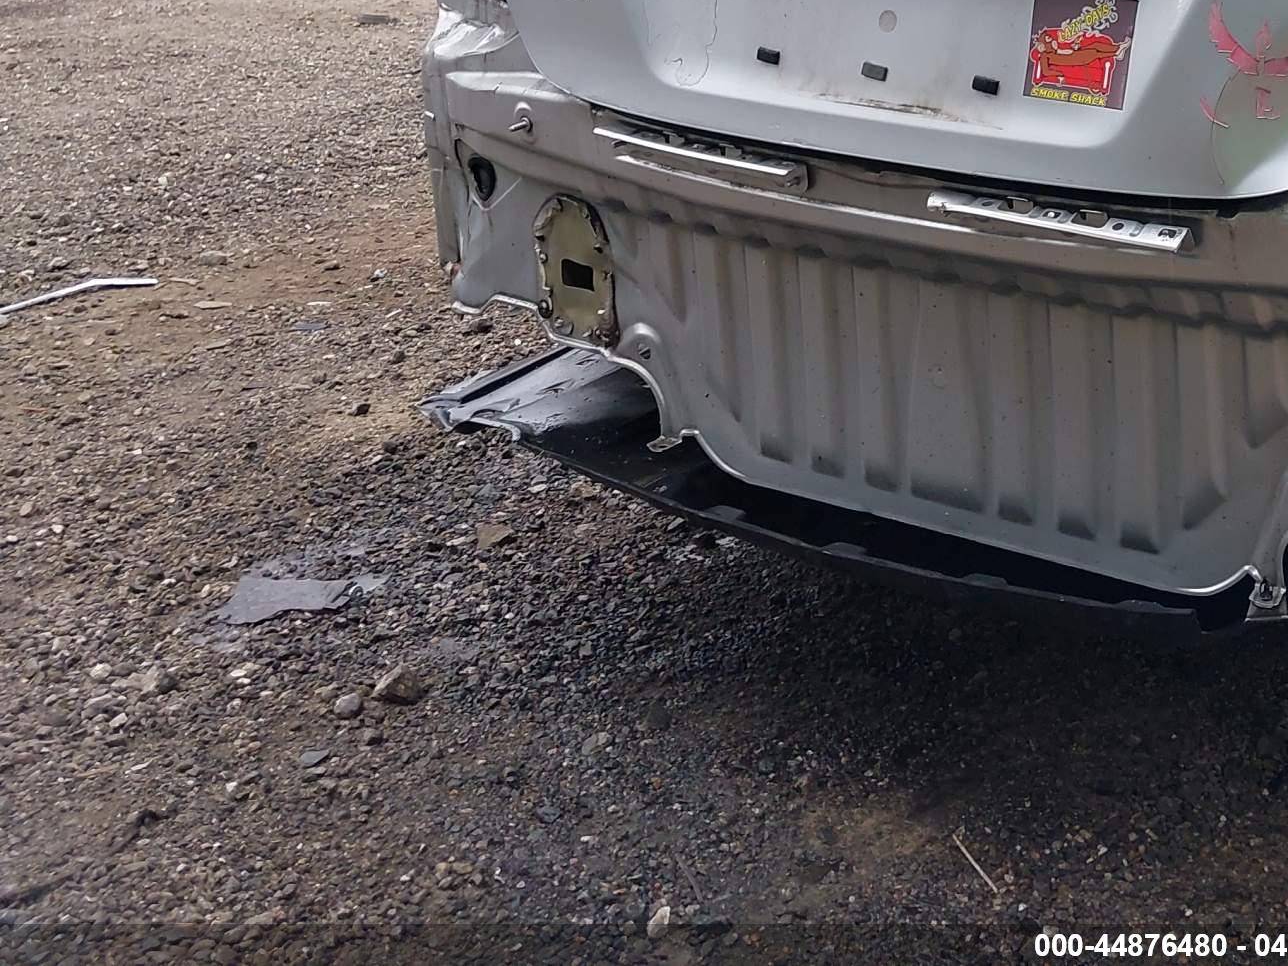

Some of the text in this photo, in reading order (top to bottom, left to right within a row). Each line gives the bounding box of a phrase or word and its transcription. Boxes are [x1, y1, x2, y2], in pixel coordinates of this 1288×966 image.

[1058, 3, 1111, 43] LAZY DAYS
[1031, 87, 1107, 107] SMOKE SHACK
